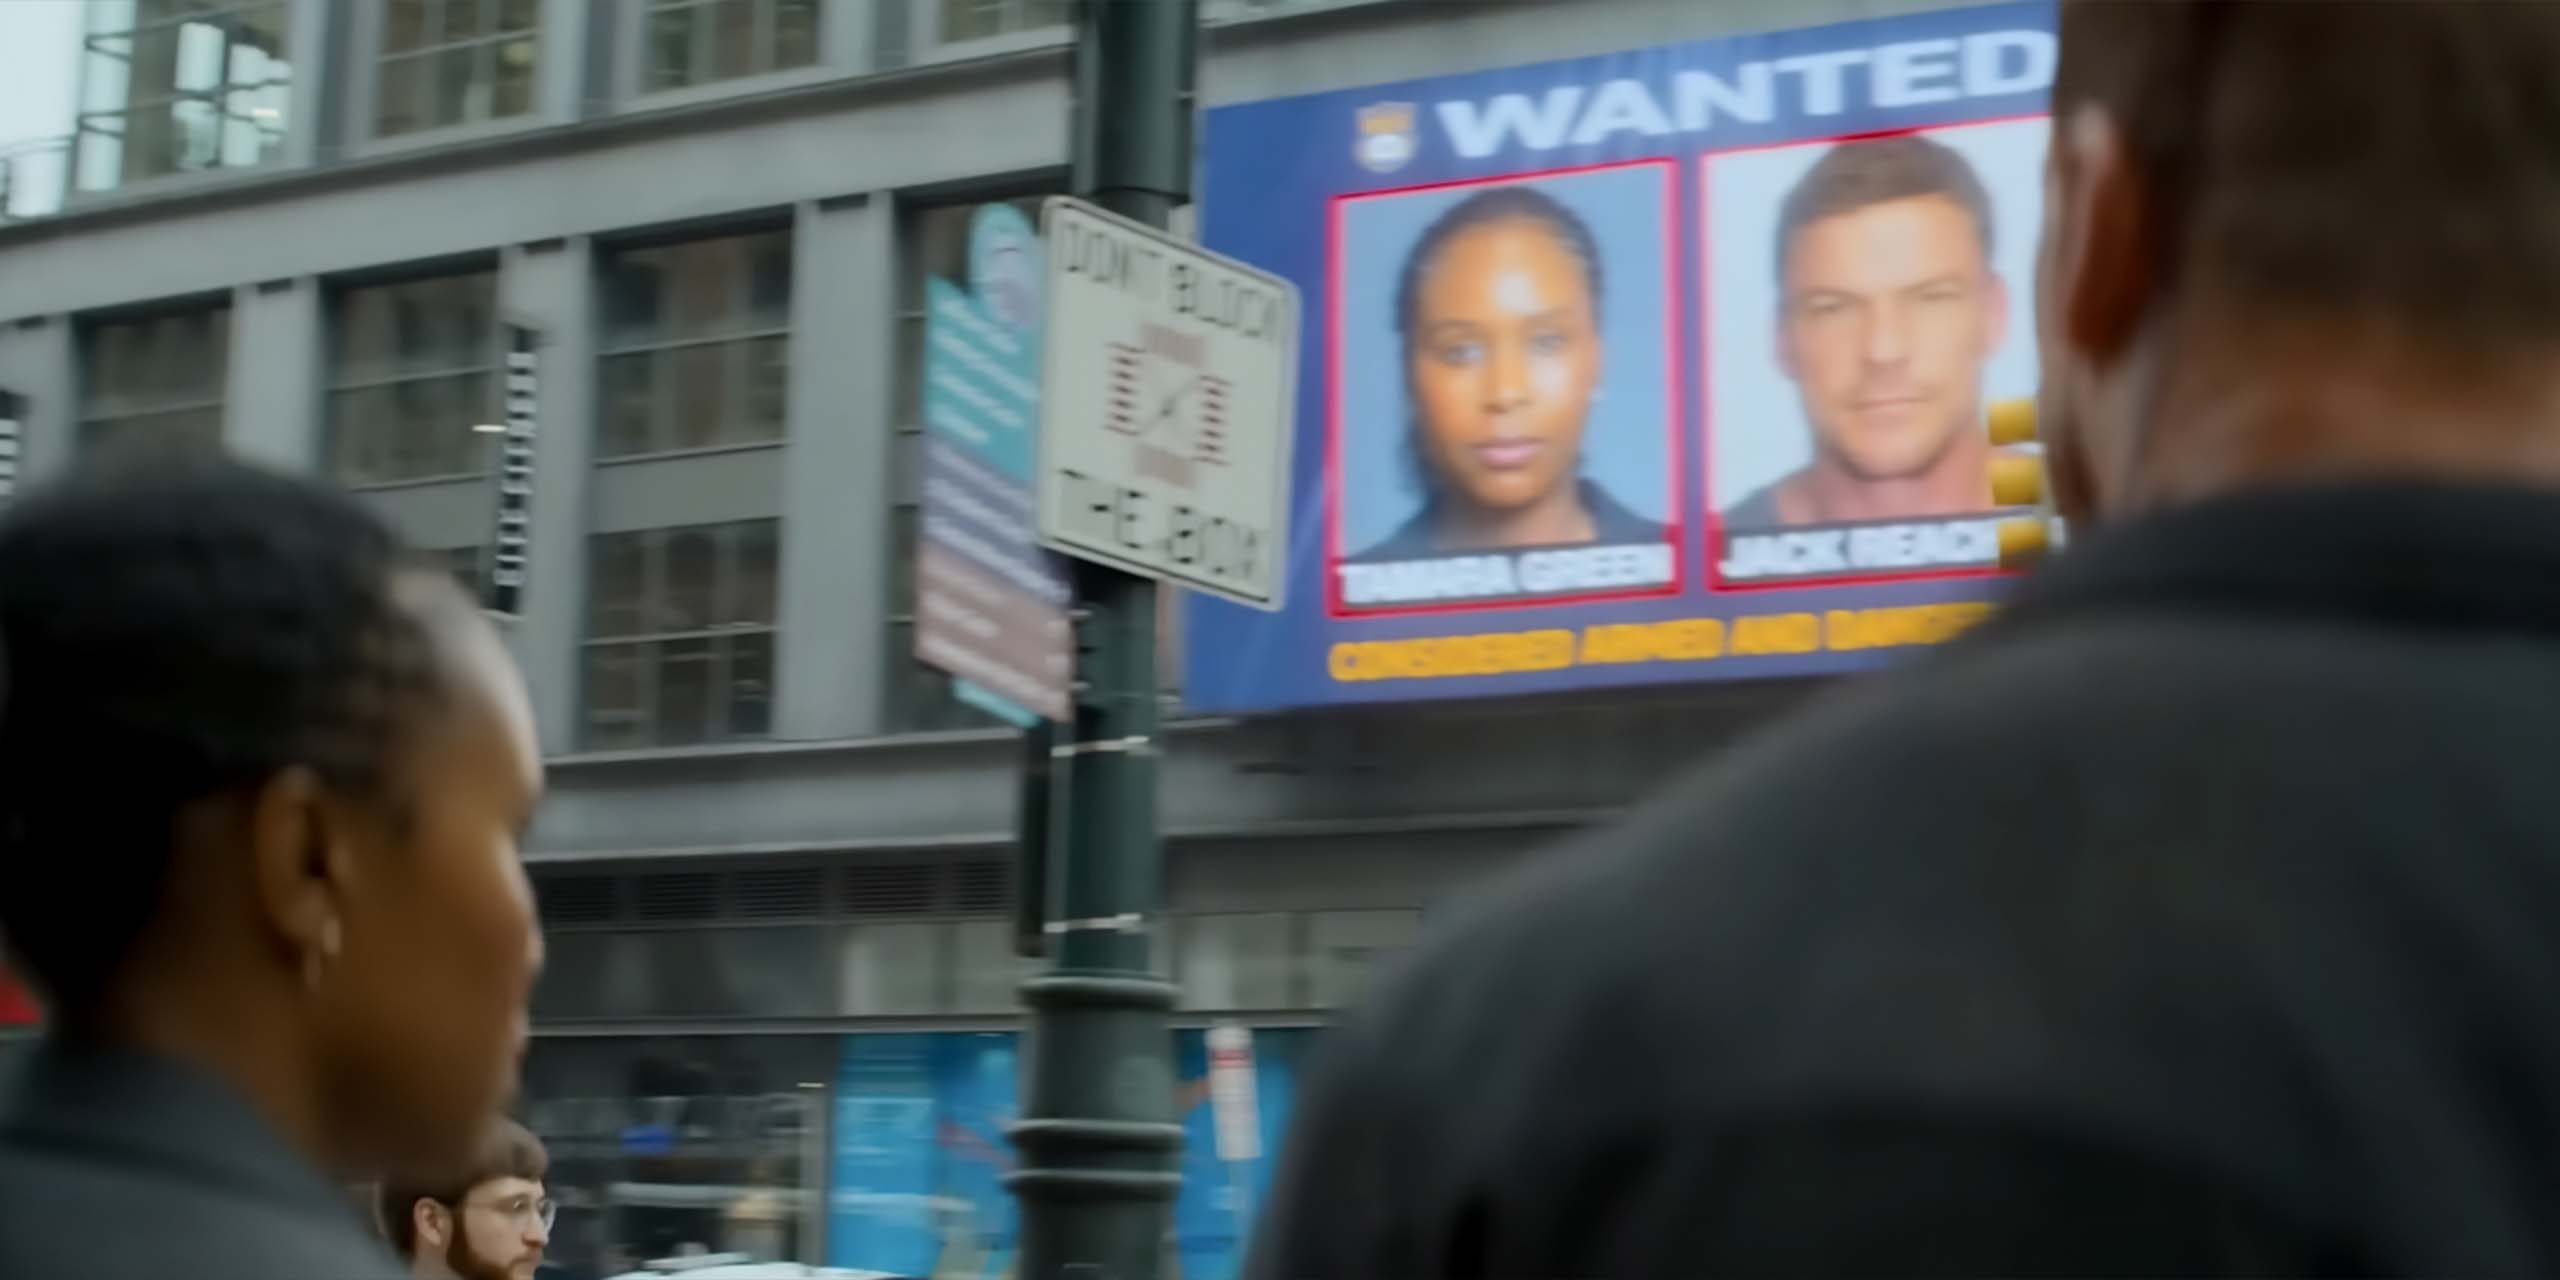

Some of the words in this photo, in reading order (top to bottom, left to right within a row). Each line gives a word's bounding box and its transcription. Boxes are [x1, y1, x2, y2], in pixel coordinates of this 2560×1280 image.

[1436, 30, 2057, 158] WANTED
[1166, 262, 1284, 345] BLOCK
[1057, 467, 1148, 552] THE
[1164, 504, 1268, 588] BOX
[1717, 530, 1849, 578] JACK
[1337, 553, 1519, 604] TAMARA
[1518, 542, 1678, 593] GREEN
[1329, 629, 1577, 682] CONSIDERED
[1581, 616, 1726, 664] ARMED
[1729, 612, 1820, 656] AND
